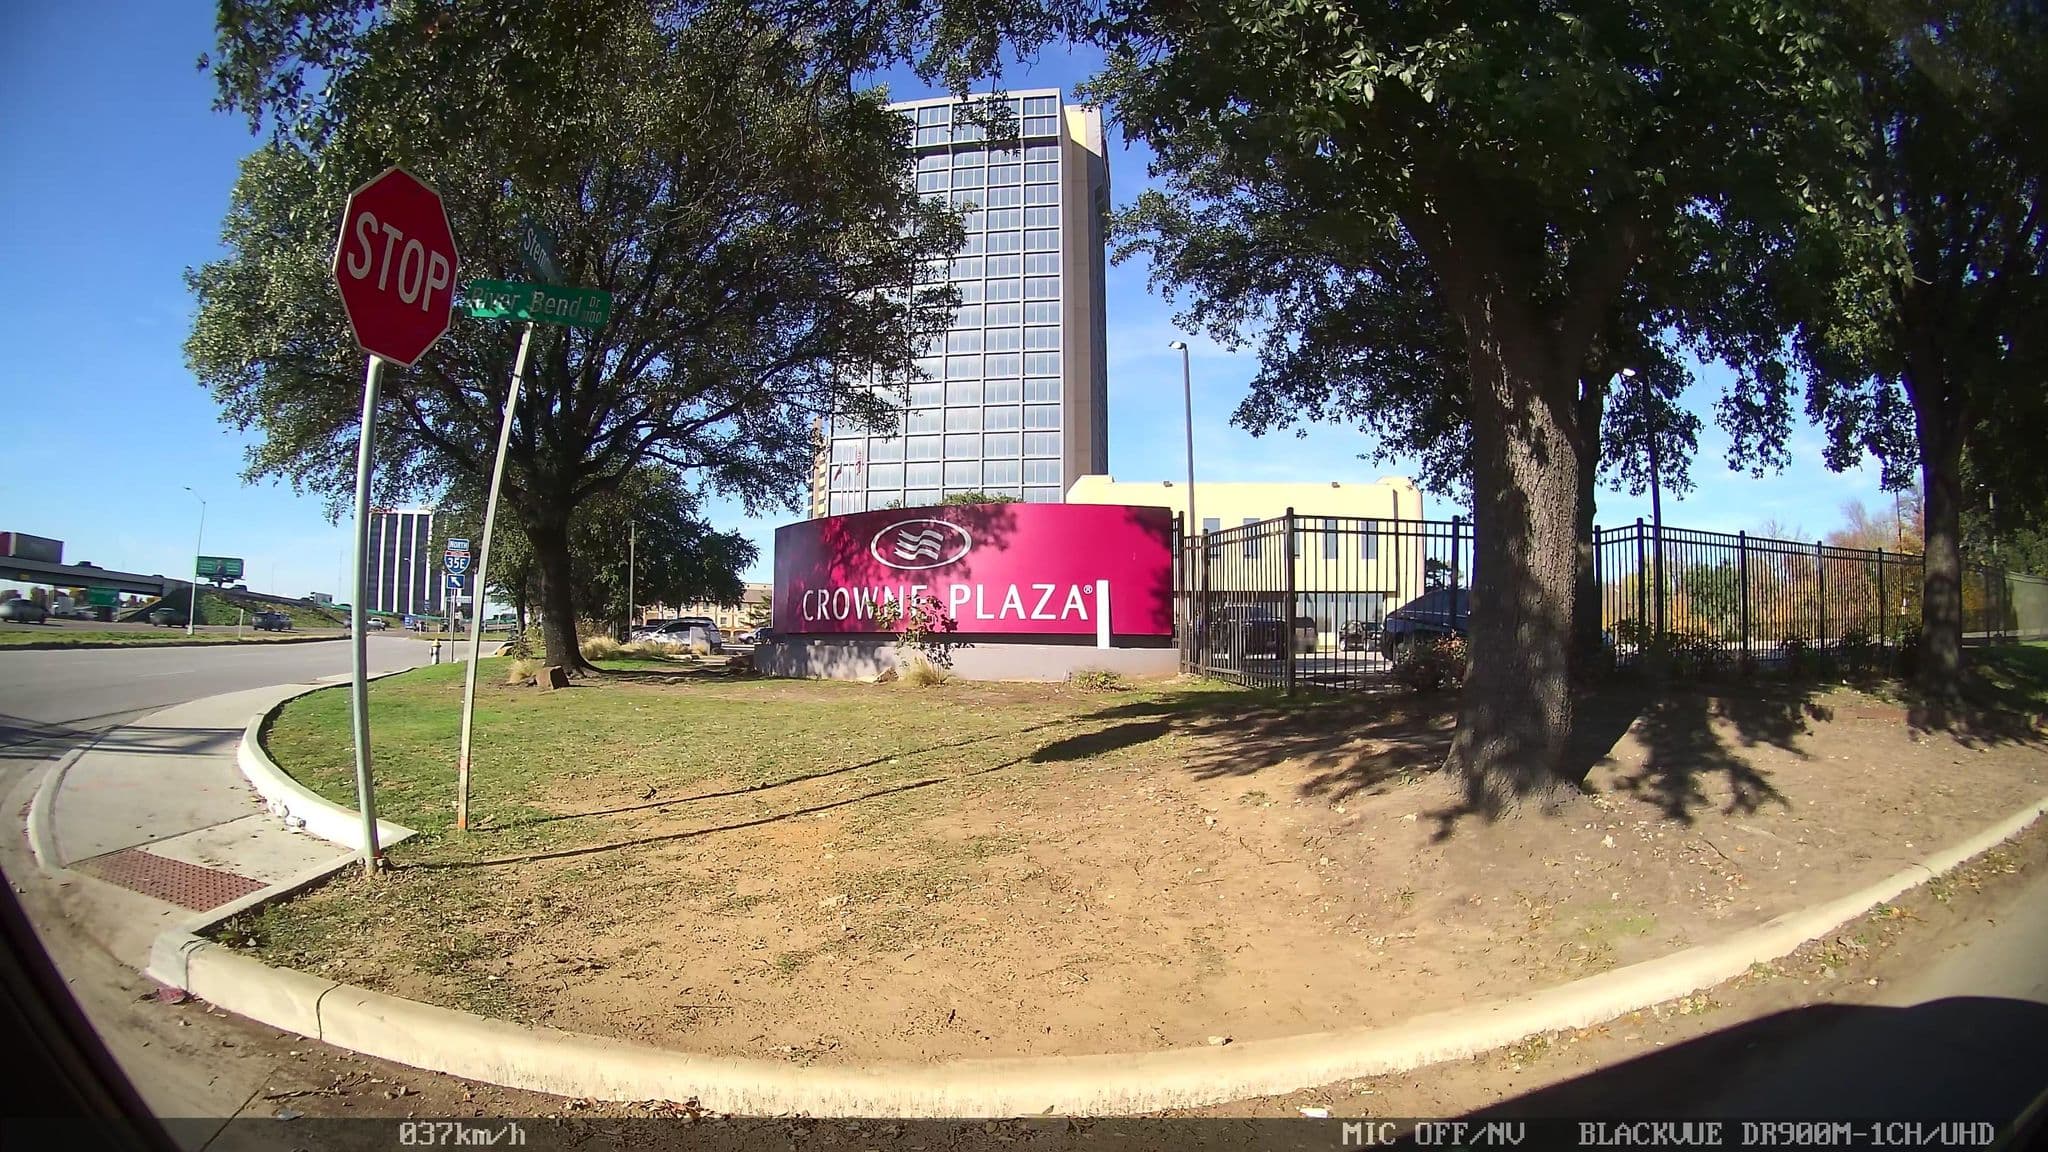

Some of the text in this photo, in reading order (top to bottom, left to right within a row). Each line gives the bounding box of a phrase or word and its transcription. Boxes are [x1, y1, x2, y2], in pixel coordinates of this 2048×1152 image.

[346, 211, 450, 312] STOP
[530, 291, 583, 318] Bend
[589, 296, 601, 308] Dr
[448, 541, 469, 549] NORTH
[447, 557, 466, 569] 35E
[802, 584, 930, 622] CROWNE
